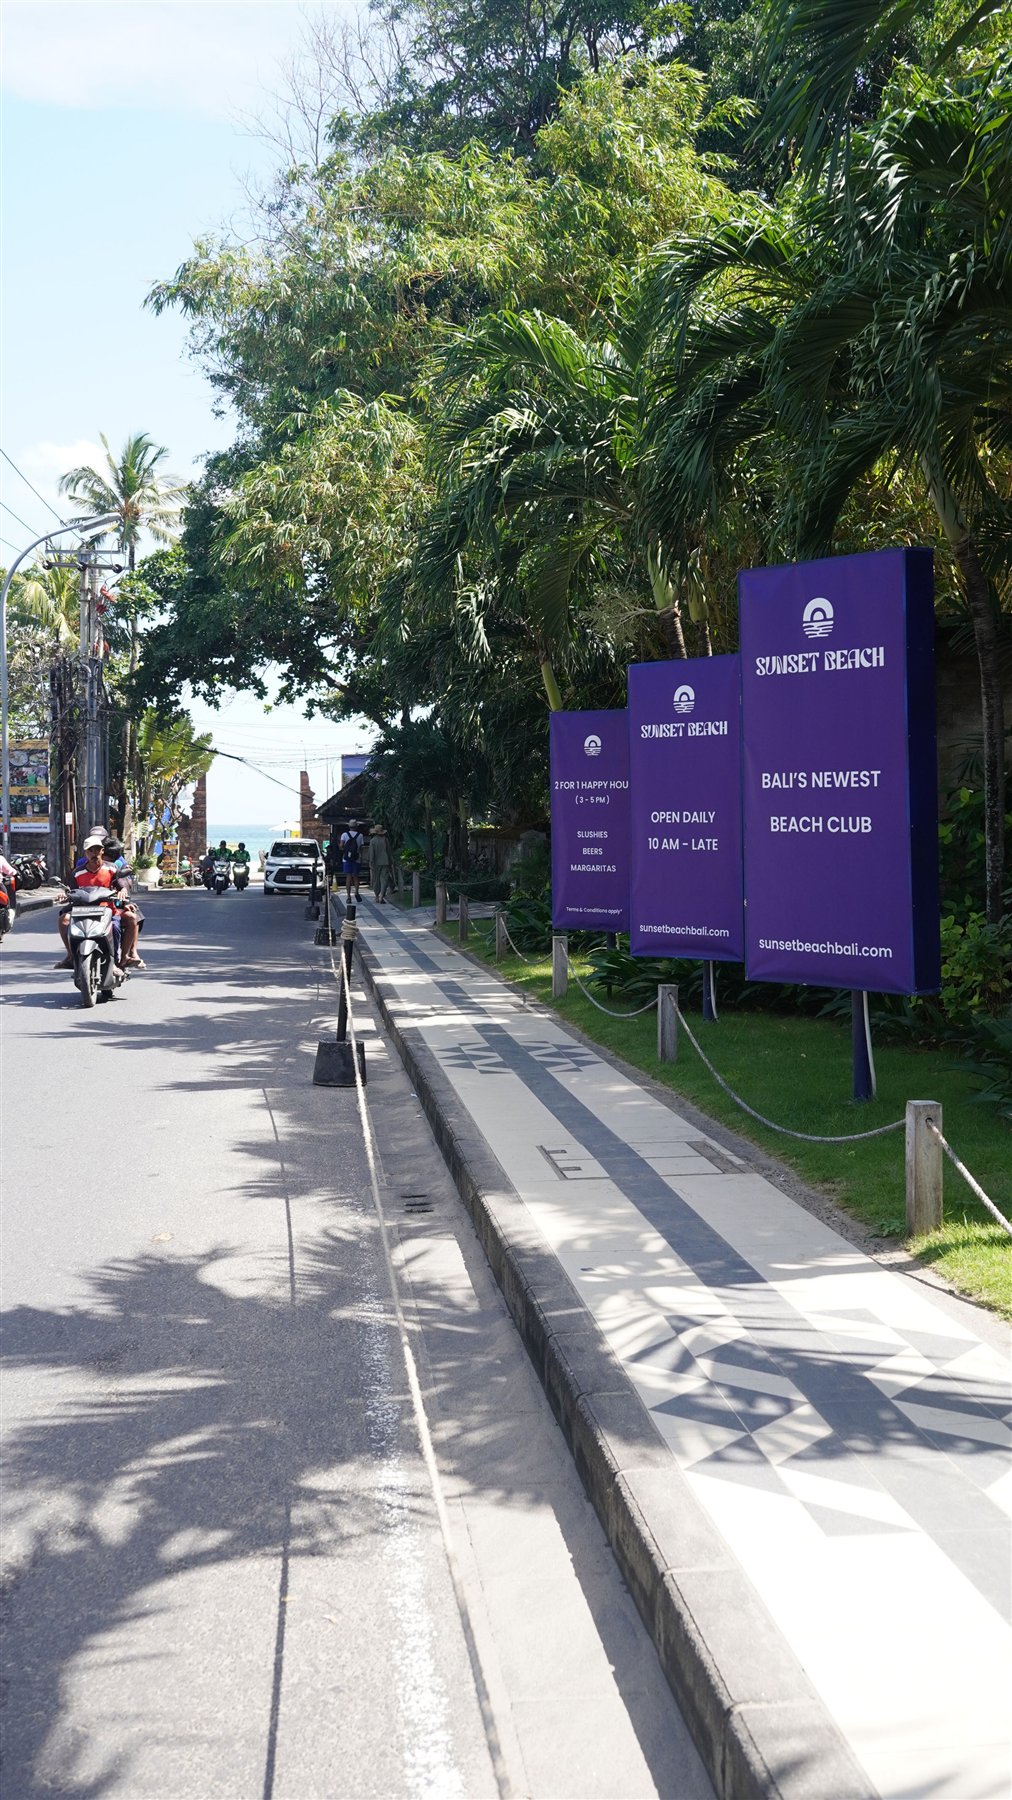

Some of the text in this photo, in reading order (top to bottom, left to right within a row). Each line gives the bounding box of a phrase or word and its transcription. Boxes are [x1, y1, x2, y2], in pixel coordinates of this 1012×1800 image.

[756, 646, 885, 675] SUNSET BEACH
[640, 720, 728, 738] SUNSET BEACH
[555, 781, 559, 790] 2
[560, 781, 575, 790] FOR
[581, 780, 608, 789] HAPPY
[609, 780, 629, 789] HOU
[811, 770, 880, 788] NEWEST
[651, 811, 716, 823] OPEN DAILY
[770, 816, 872, 832] BEACH CLUB
[582, 847, 603, 855] BEERS
[647, 838, 659, 850] 10
[661, 838, 679, 850] AM
[691, 838, 719, 850] LATE
[570, 864, 616, 872] MARGARITAS
[639, 924, 730, 938] sunsetbeachbali.com
[759, 938, 893, 958] sunsetbeachbali.com
